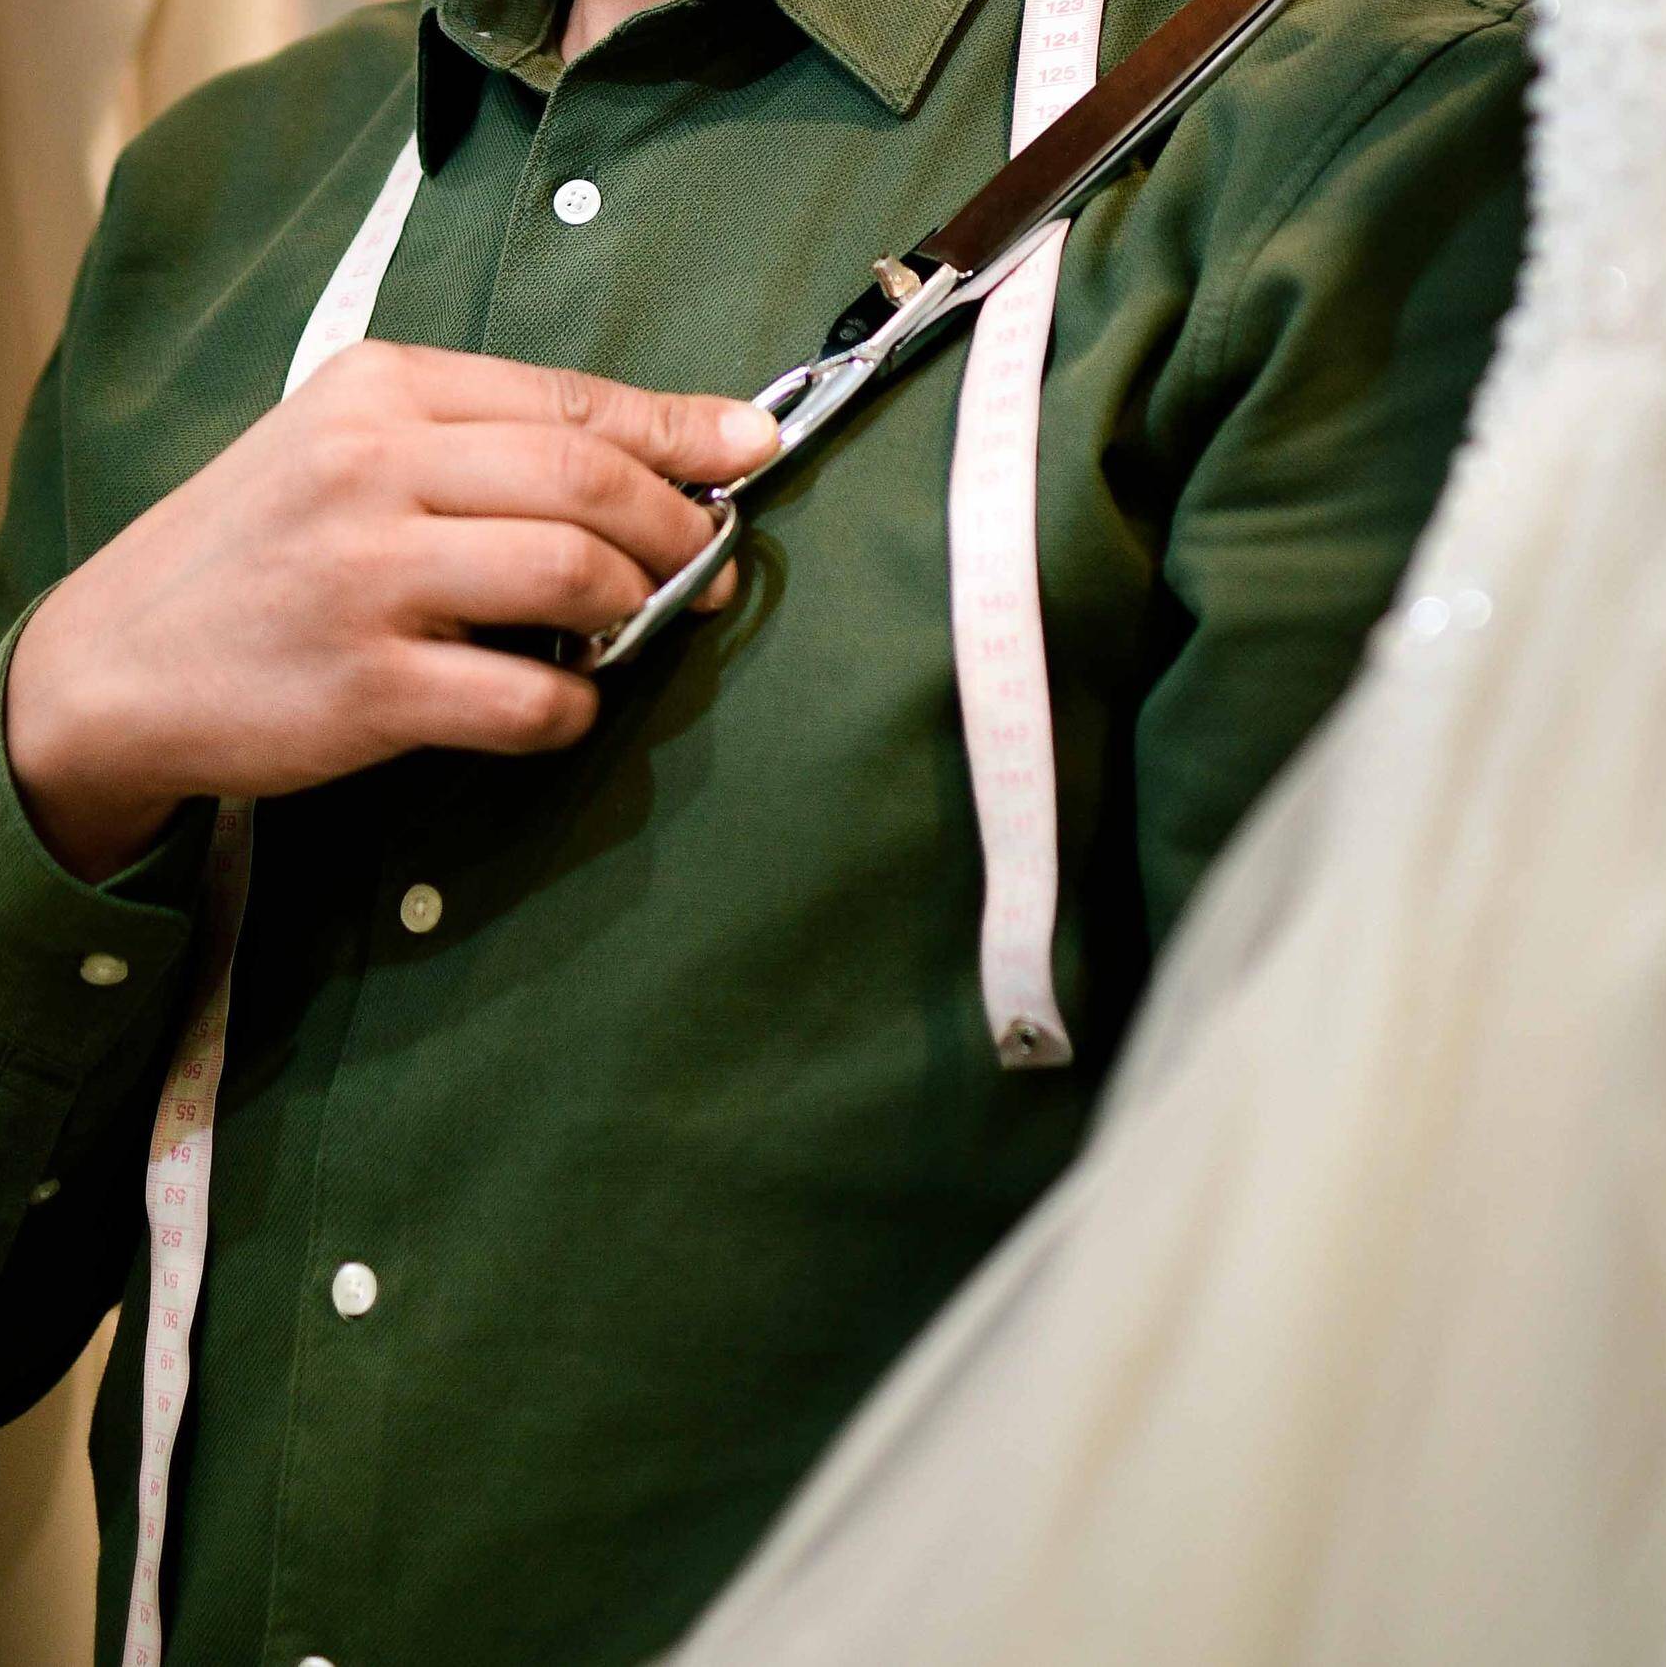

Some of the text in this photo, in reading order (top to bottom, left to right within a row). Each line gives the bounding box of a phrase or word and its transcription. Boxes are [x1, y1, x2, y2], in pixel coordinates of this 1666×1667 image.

[1042, 31, 1080, 47] 124
[1038, 65, 1078, 83] 125
[183, 1063, 203, 1079] 56
[176, 1104, 196, 1121] 55
[169, 1145, 191, 1163] 54
[164, 1188, 187, 1205] 53
[161, 1230, 182, 1247] 52
[162, 1272, 179, 1288] 51
[163, 1312, 178, 1329] 50
[160, 1354, 175, 1370] 49
[157, 1395, 171, 1412] 48
[140, 1607, 151, 1625] 43
[136, 1649, 149, 1666] 42
